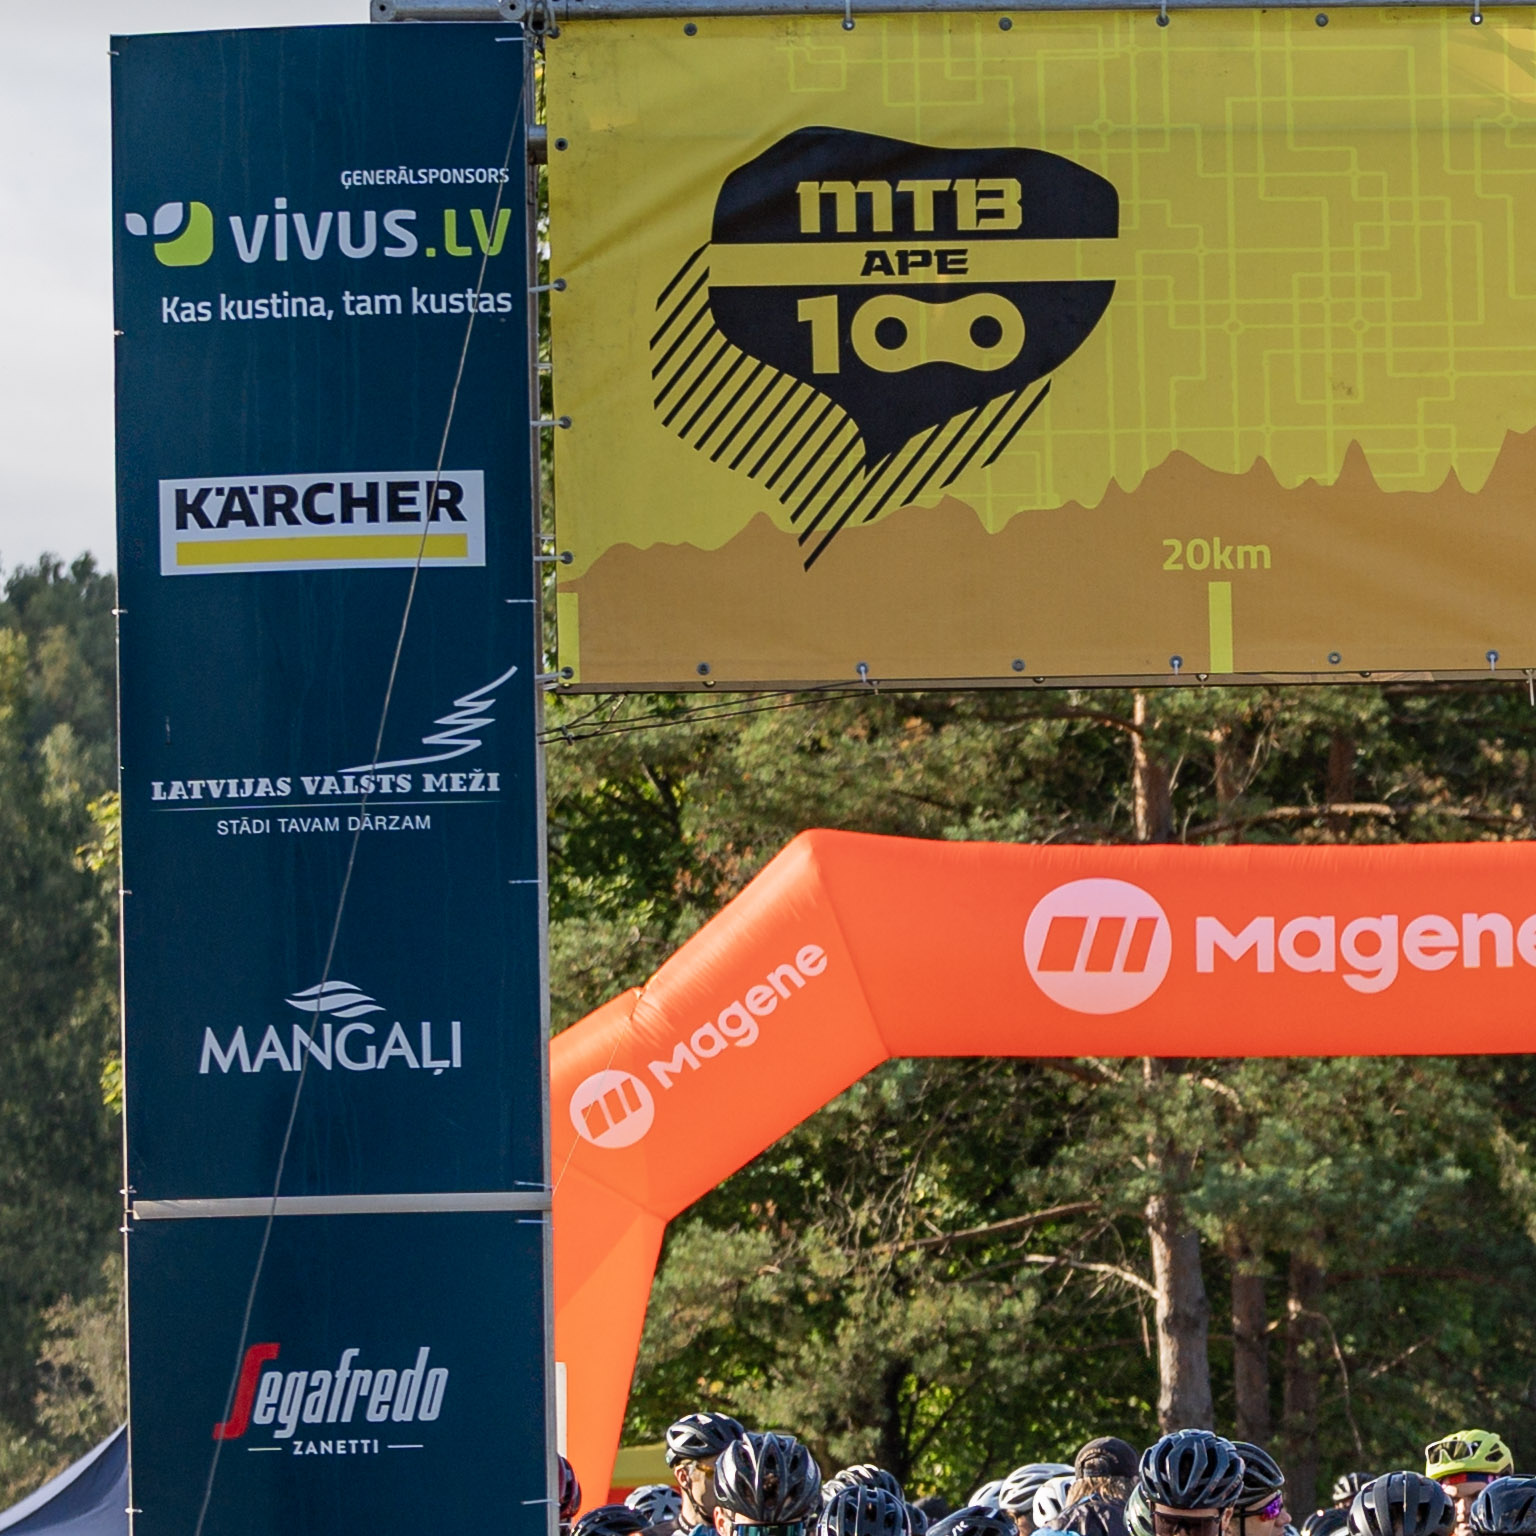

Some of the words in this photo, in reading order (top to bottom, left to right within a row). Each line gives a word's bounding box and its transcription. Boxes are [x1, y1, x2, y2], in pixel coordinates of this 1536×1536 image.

[340, 165, 510, 190] ĢENERĀLSPONSORS
[796, 178, 1023, 233] MTB
[860, 248, 969, 277] APE
[161, 295, 212, 324] Kas
[219, 291, 334, 323] kustina,
[342, 289, 402, 317] tam
[411, 287, 513, 315] kustas
[797, 292, 1025, 375] 100
[174, 480, 467, 531] KÄRCHER
[1162, 538, 1272, 571] 20km
[151, 776, 292, 801] LATVIJAS
[301, 773, 412, 797] VALSTS
[422, 767, 501, 794] MEŽI
[217, 815, 271, 836] STĀDI
[277, 816, 340, 834] TAVAM
[347, 812, 432, 831] DĀRZAM
[647, 943, 829, 1092] Magene
[199, 1020, 463, 1076] MANGAĻI
[212, 1342, 449, 1440] Segafredo
[292, 1438, 380, 1456] ZANETTI
